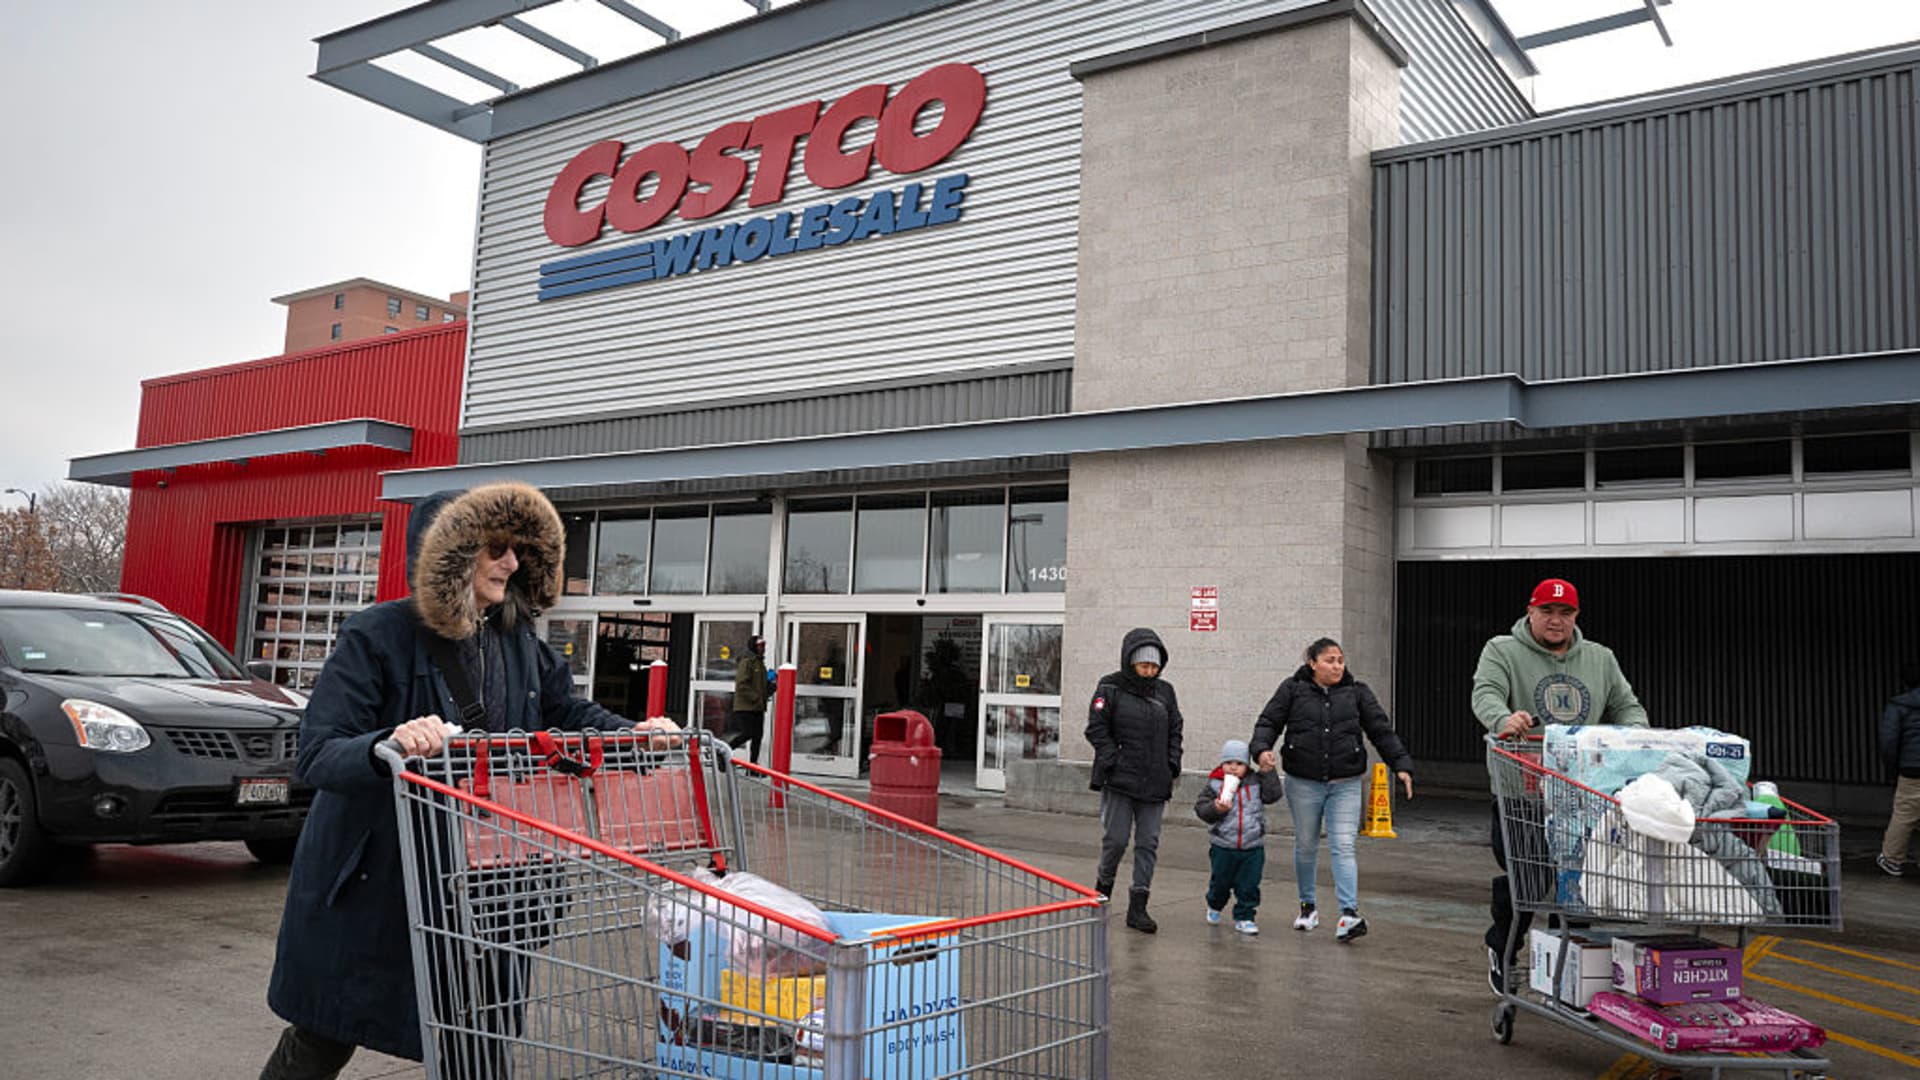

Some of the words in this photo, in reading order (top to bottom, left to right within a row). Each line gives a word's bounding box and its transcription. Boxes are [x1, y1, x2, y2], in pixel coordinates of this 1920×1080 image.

[543, 62, 987, 247] COSTCO
[652, 174, 967, 280] WHOLESALE
[1029, 567, 1068, 582] 1430
[1552, 584, 1564, 597] B
[1673, 968, 1728, 985] KITCHEN
